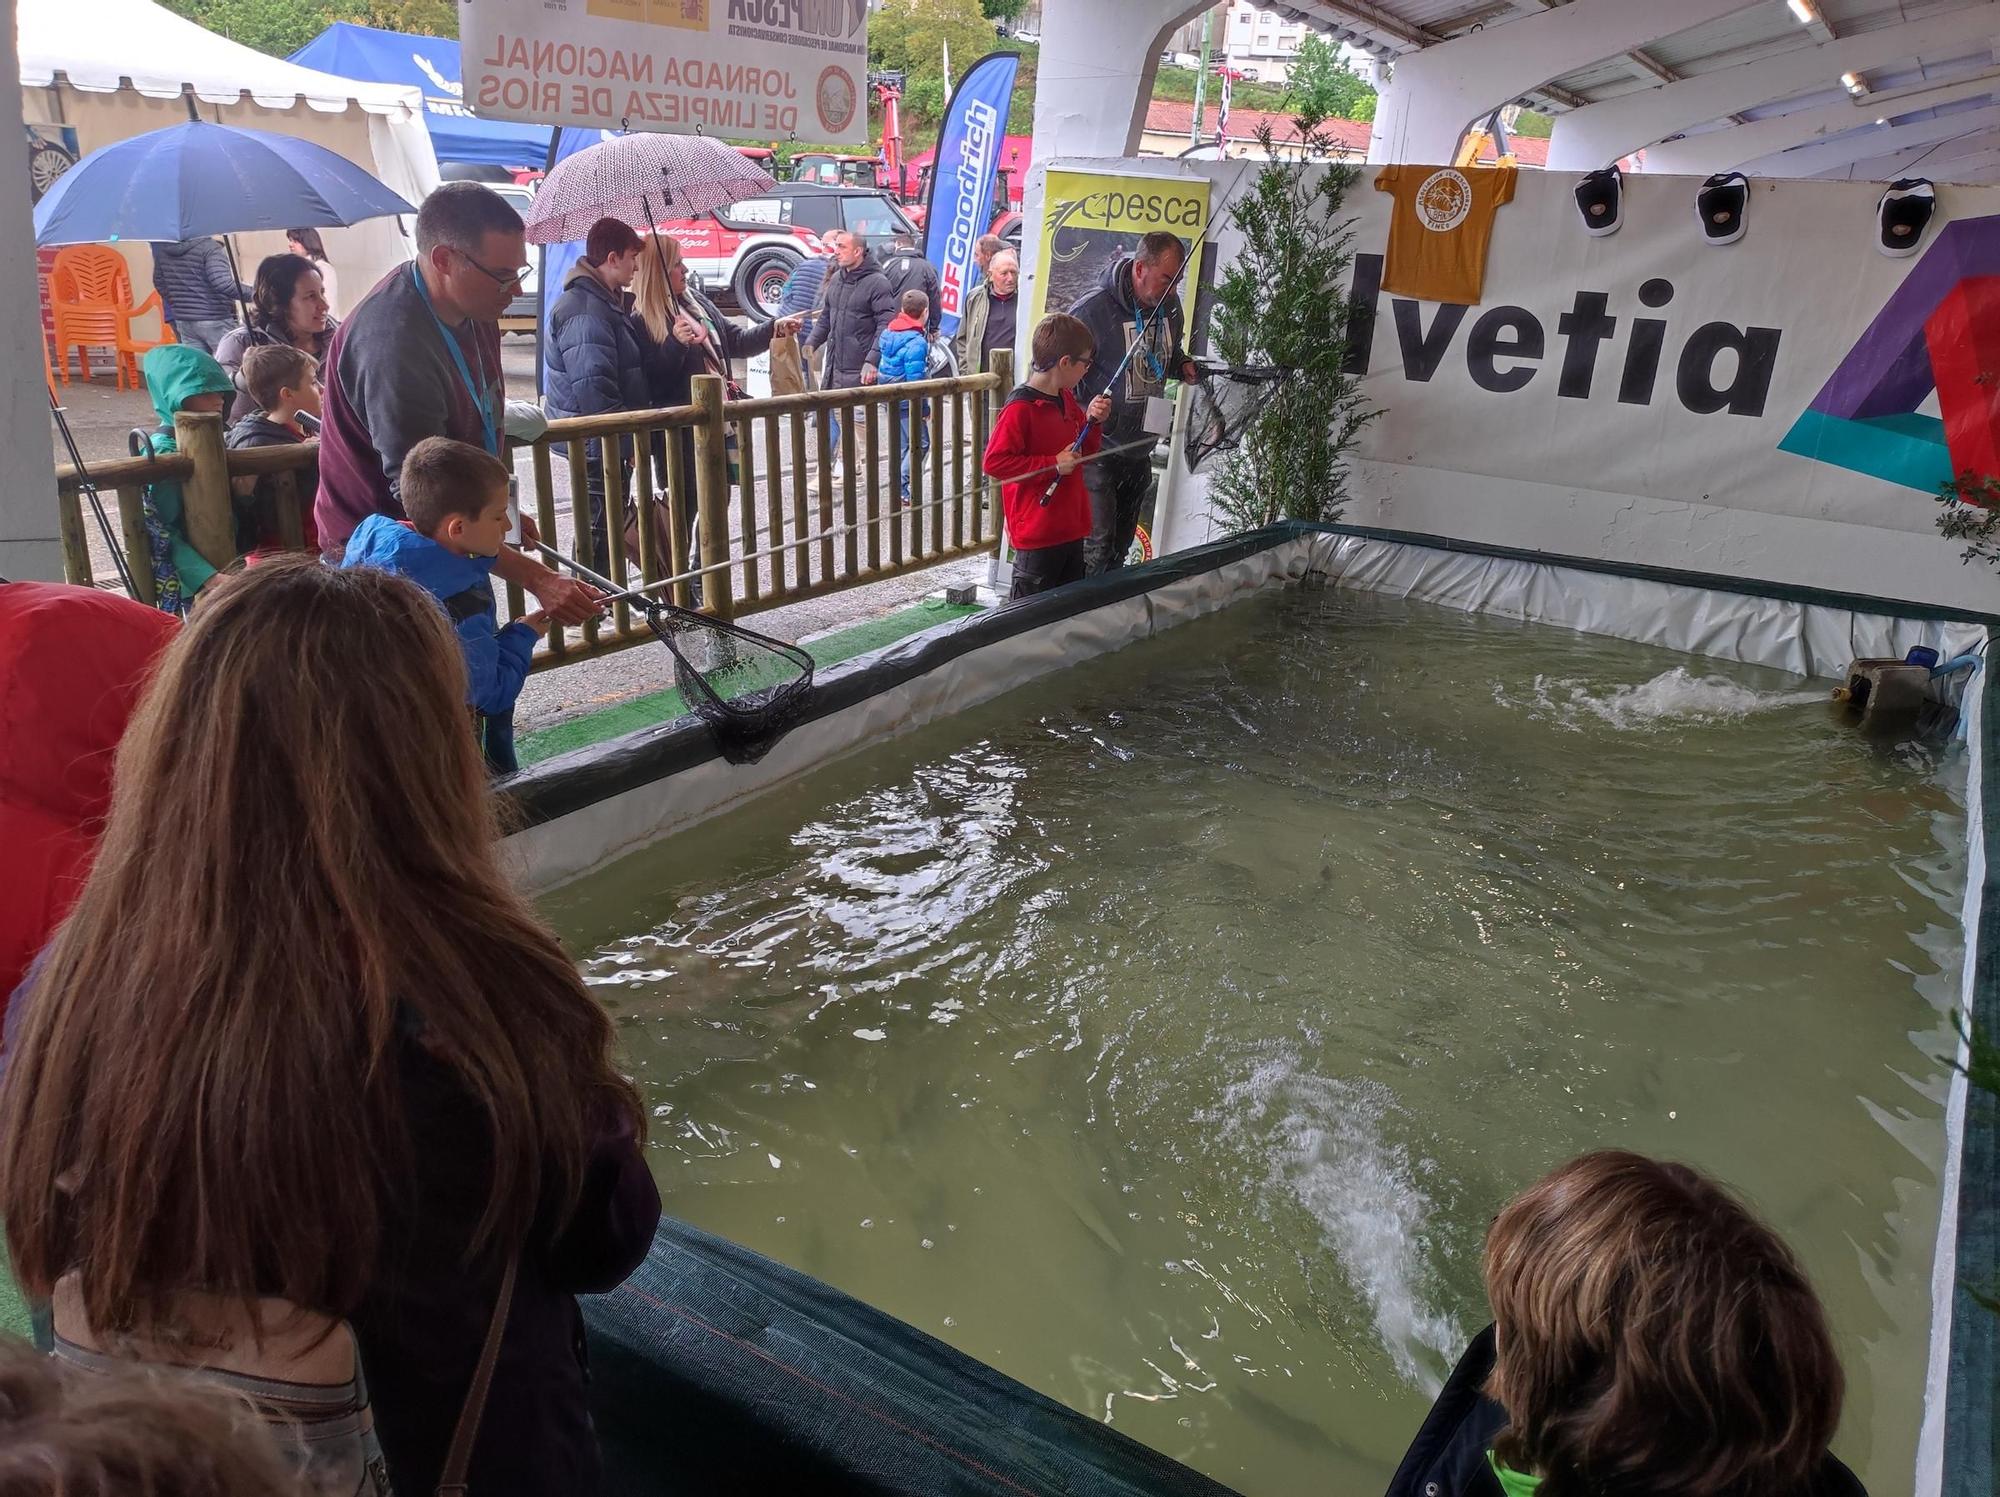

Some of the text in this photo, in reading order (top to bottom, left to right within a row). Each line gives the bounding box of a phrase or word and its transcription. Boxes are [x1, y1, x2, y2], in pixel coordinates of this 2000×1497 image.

[941, 103, 988, 314] BFGoodrich
[1106, 192, 1201, 227] pesca
[1428, 220, 1450, 230] TINEO
